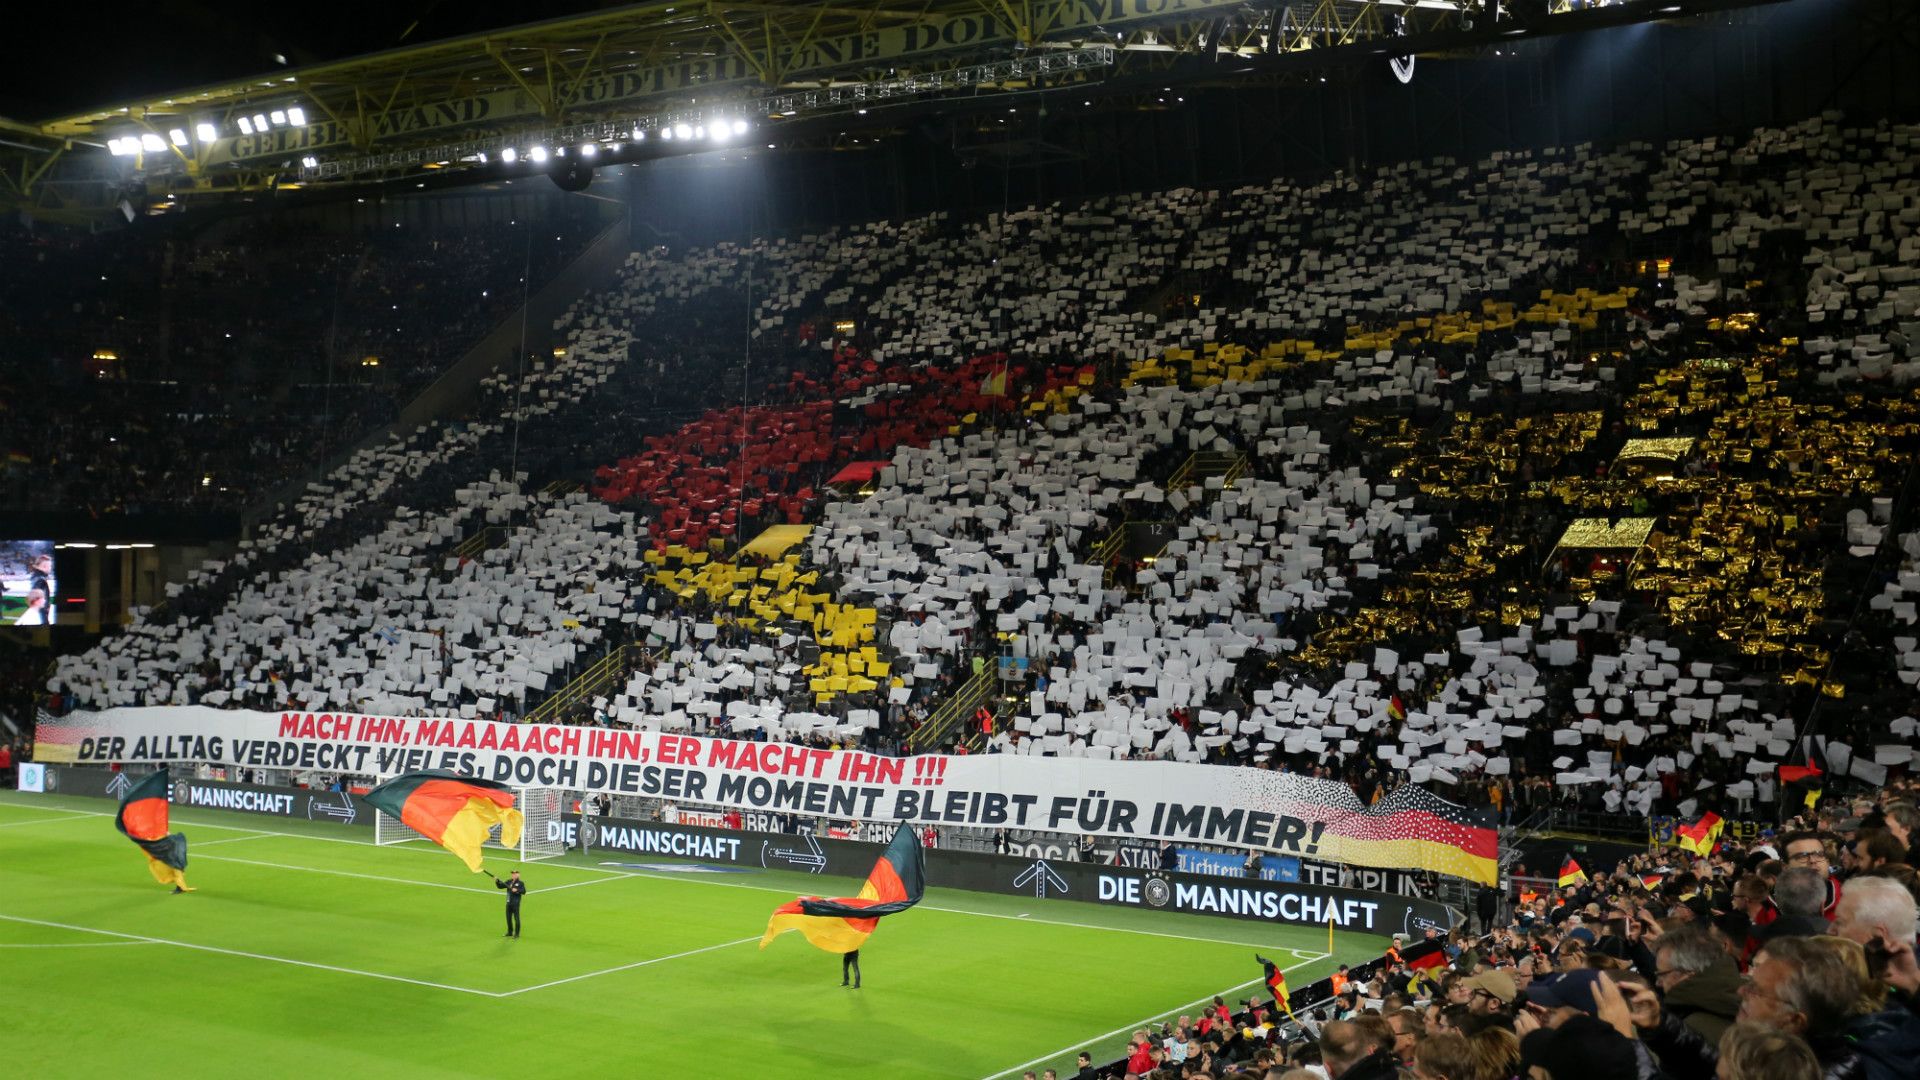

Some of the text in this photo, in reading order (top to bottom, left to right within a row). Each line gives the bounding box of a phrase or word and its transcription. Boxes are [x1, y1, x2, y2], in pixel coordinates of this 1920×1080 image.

[373, 97, 491, 136] WAND
[1150, 524, 1162, 535] 12
[279, 714, 948, 786] MACH IHN, MAAAAACH IHN, ER MACHT IHN !!!
[78, 736, 126, 761] DER
[131, 735, 224, 761] ALLTAG
[233, 740, 372, 773] VERDECKT
[493, 755, 579, 787] DOCH
[587, 762, 706, 799] DIESER
[717, 774, 884, 818] MOMENT
[893, 789, 1038, 825] BLEIBT
[1048, 789, 1139, 834] FÜR
[1150, 802, 1328, 854] IMMER!
[190, 786, 294, 814] MANNSCHAFT
[546, 819, 741, 861] DIE MANNSCHAFT
[1099, 875, 1140, 903] DIE
[1175, 883, 1379, 928] MANNSCHAFT
